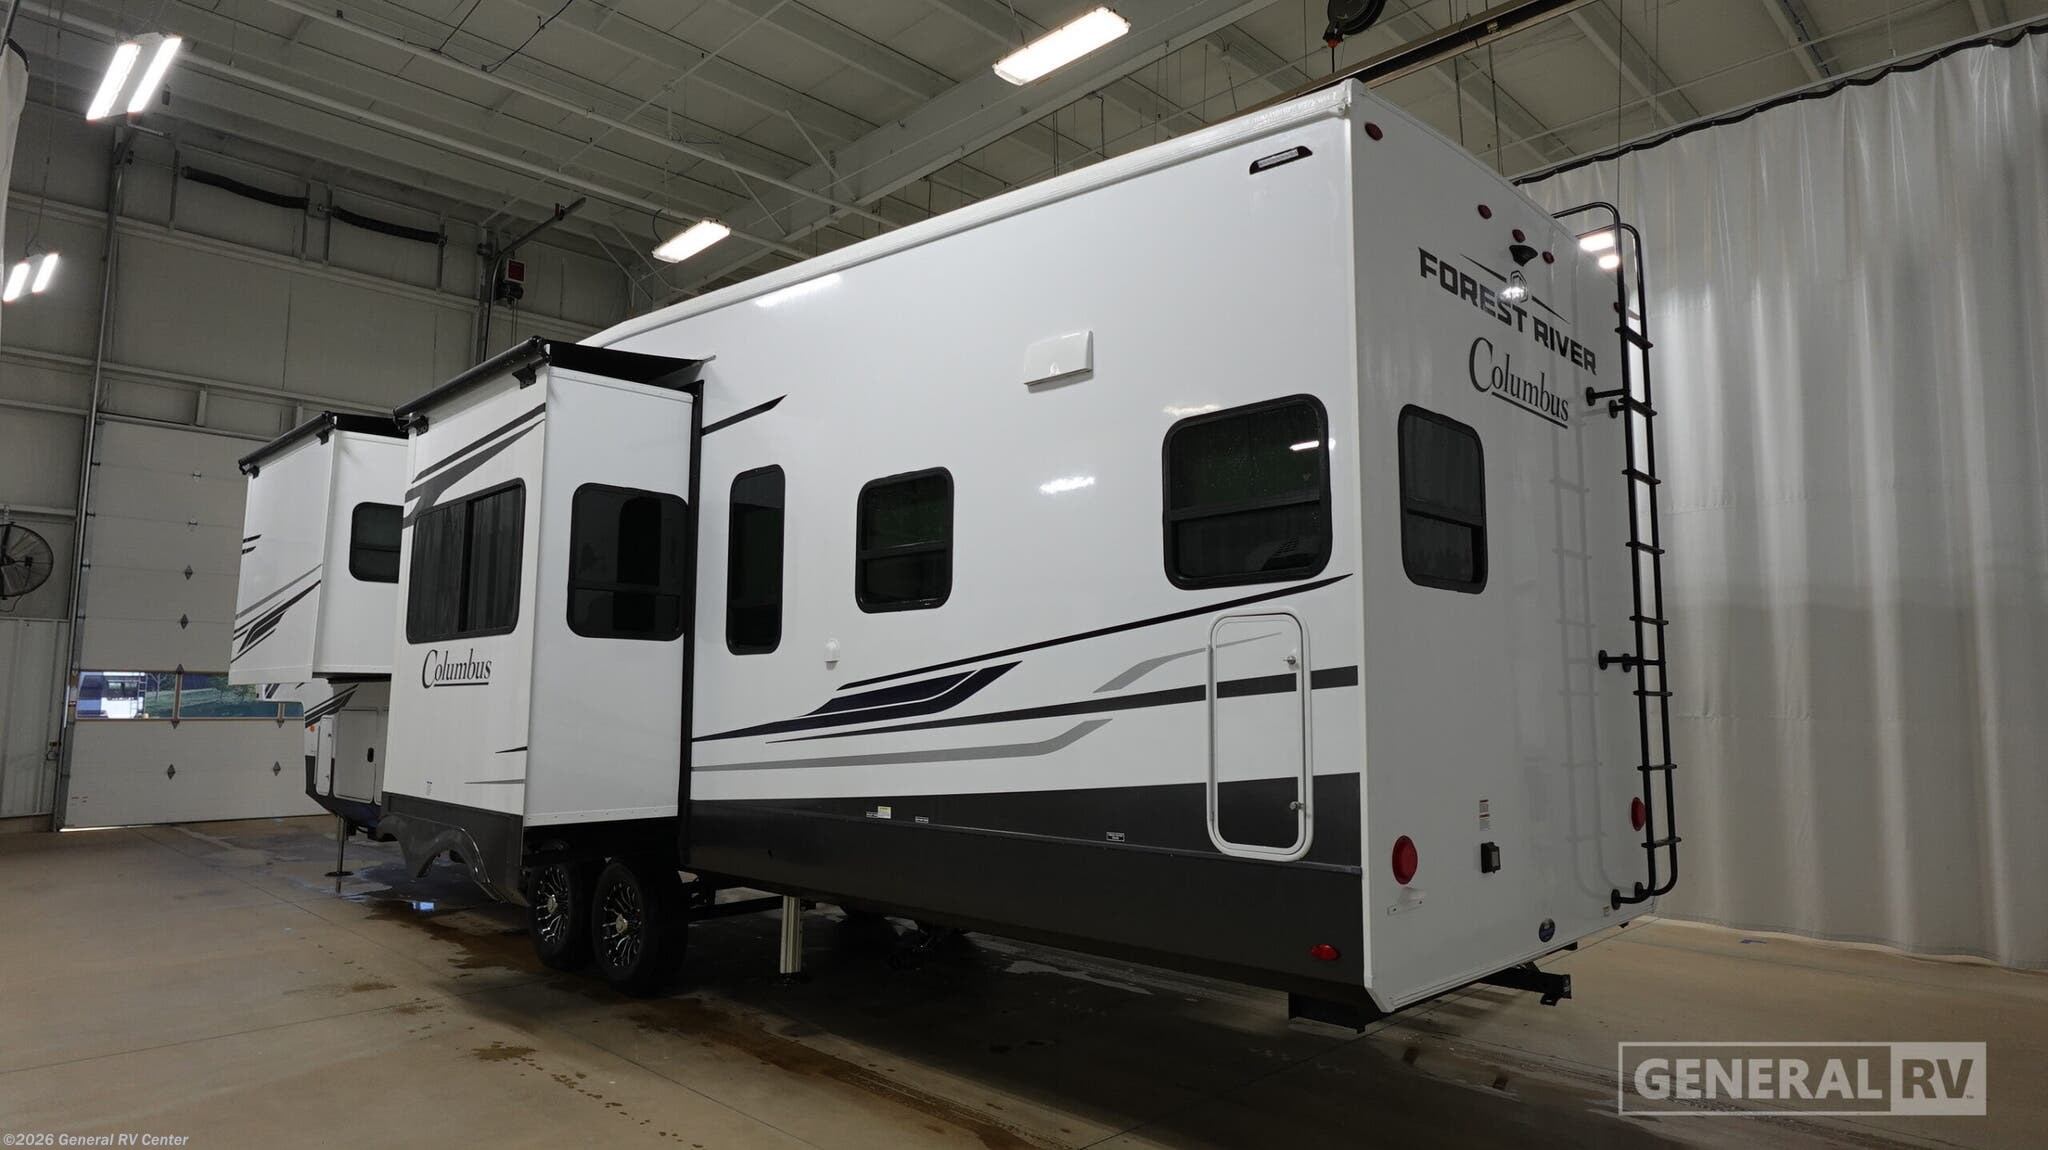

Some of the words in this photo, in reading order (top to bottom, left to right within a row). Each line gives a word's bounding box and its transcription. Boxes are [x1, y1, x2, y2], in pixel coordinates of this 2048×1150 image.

[1418, 247, 1527, 333] FOREST
[1534, 316, 1597, 375] RIVER
[1469, 337, 1569, 422] Columbus
[422, 648, 492, 689] Columbus
